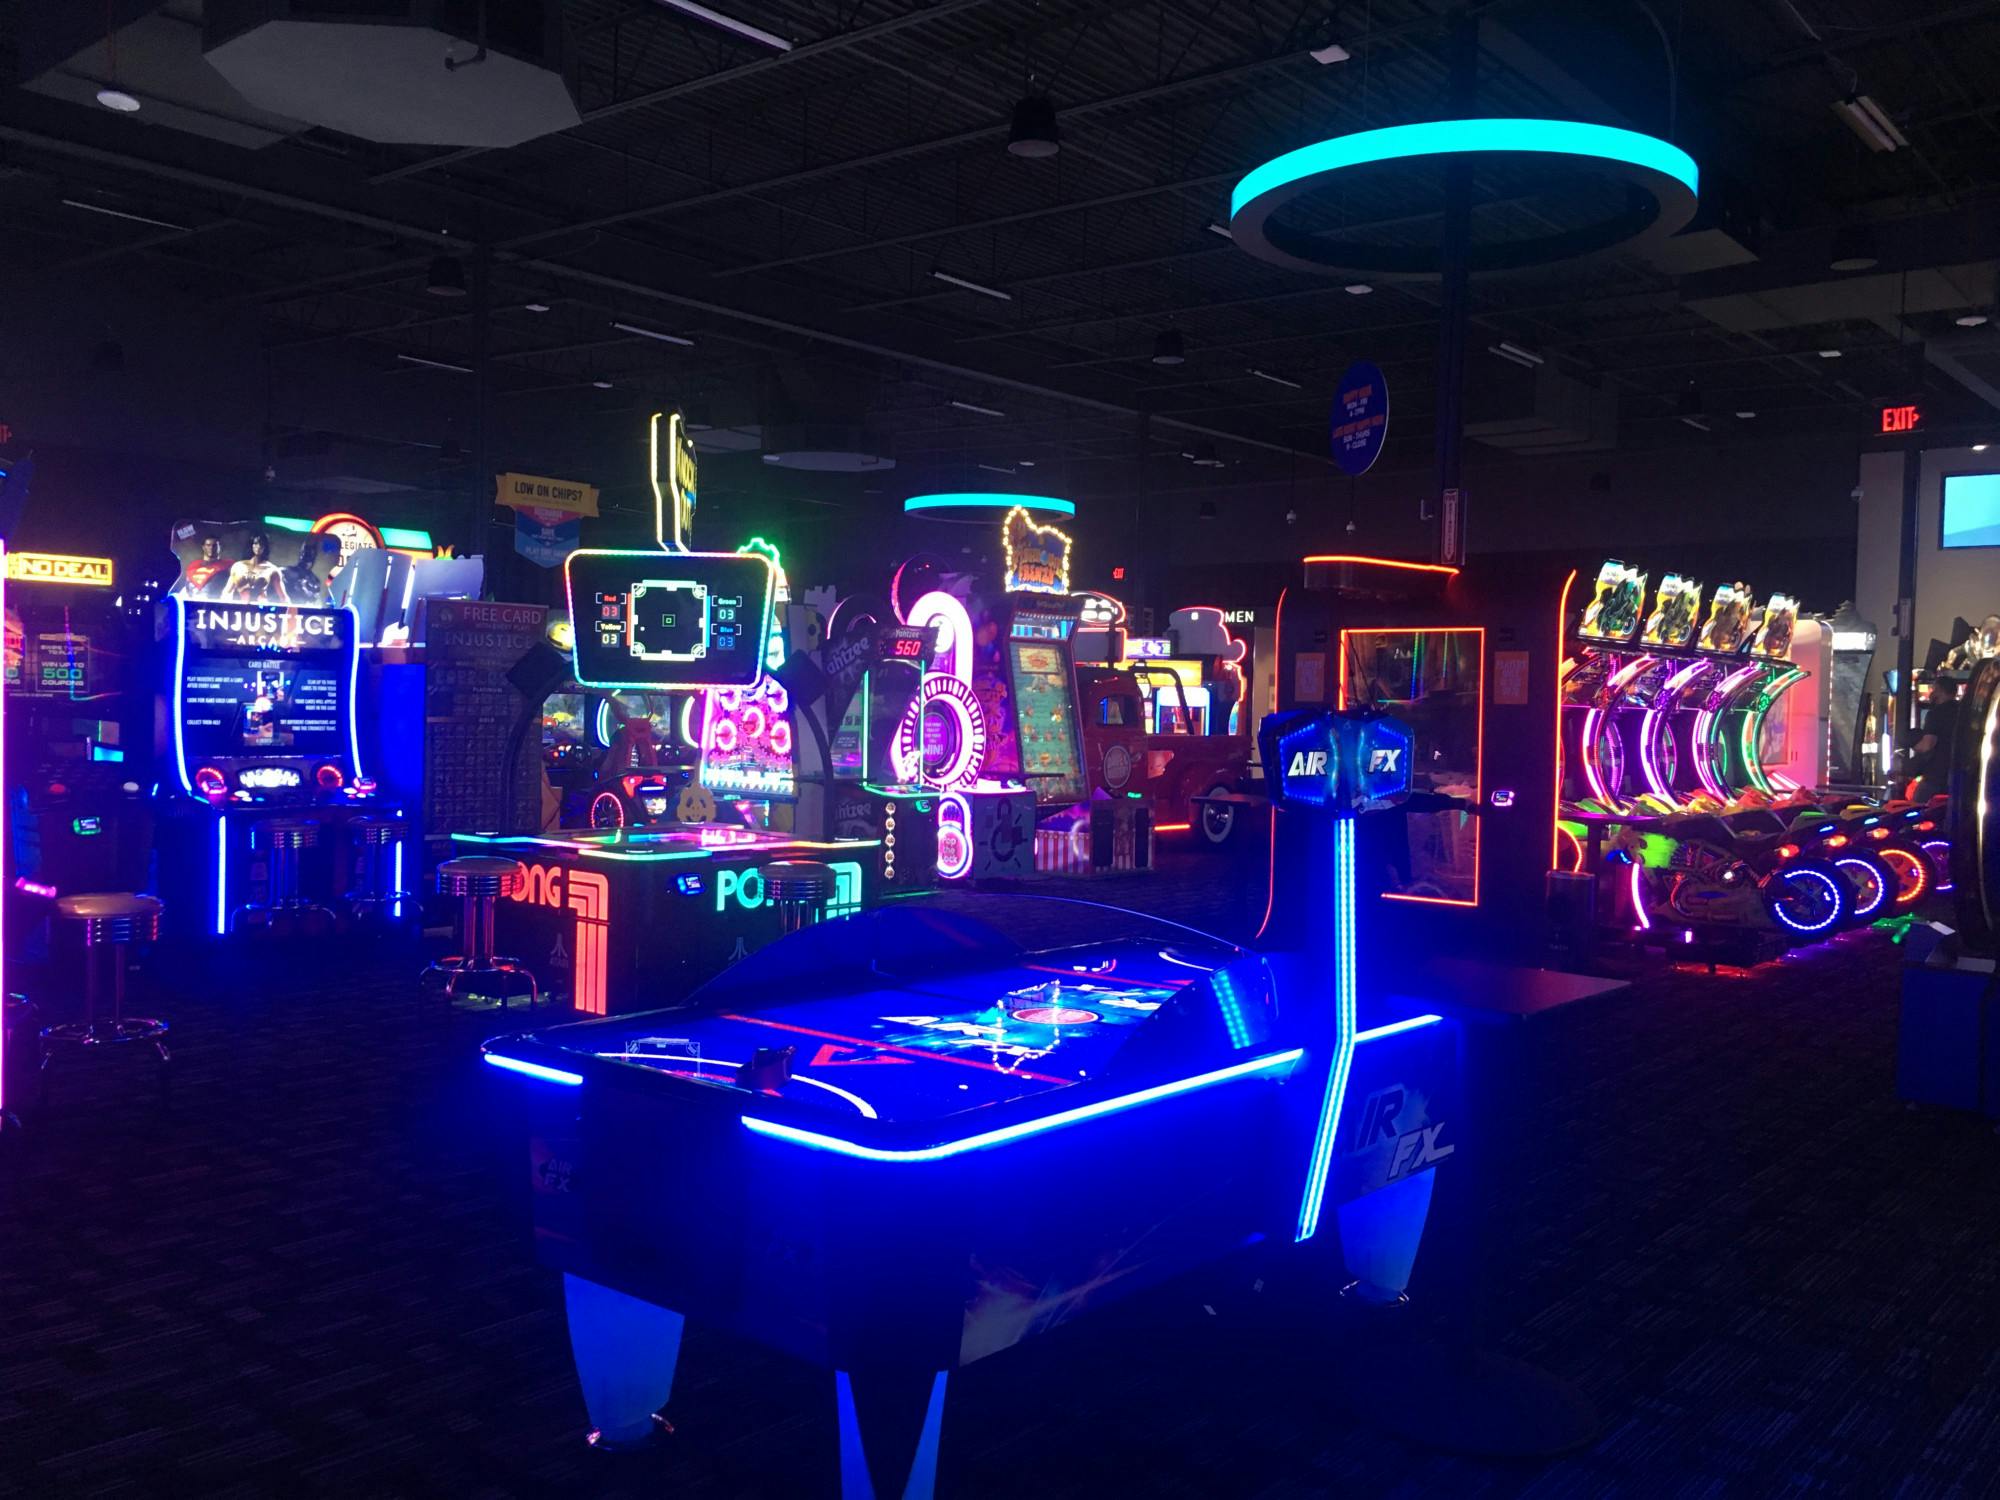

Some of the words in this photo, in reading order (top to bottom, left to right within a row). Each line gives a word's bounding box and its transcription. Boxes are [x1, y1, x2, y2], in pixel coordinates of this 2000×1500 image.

[1883, 406, 1916, 432] EXIT
[515, 482, 534, 494] LOW
[537, 485, 549, 497] ON
[552, 487, 583, 502] CHIPS?
[21, 560, 51, 574] NO
[54, 562, 104, 578] DEAL
[464, 607, 497, 622] FREE
[502, 609, 541, 624] CARD
[602, 606, 618, 617] 03
[720, 610, 734, 619] 03
[1225, 610, 1254, 622] MEN
[196, 610, 335, 636] INJUSTICE
[445, 631, 532, 648] INJUSTICE
[602, 634, 617, 644] 03
[720, 637, 733, 646] 03
[895, 628, 920, 638] Yahtzee
[826, 636, 870, 674] ahtzee
[895, 640, 921, 655] 560
[43, 668, 82, 679] 500
[263, 661, 280, 669] BATTLE
[1288, 752, 1328, 776] AIR
[1368, 749, 1402, 772] FX
[943, 855, 958, 863] ock
[511, 862, 561, 909] ONG
[1388, 1121, 1454, 1178] FX
[546, 1158, 574, 1176] AIR
[544, 1172, 572, 1192] FX
